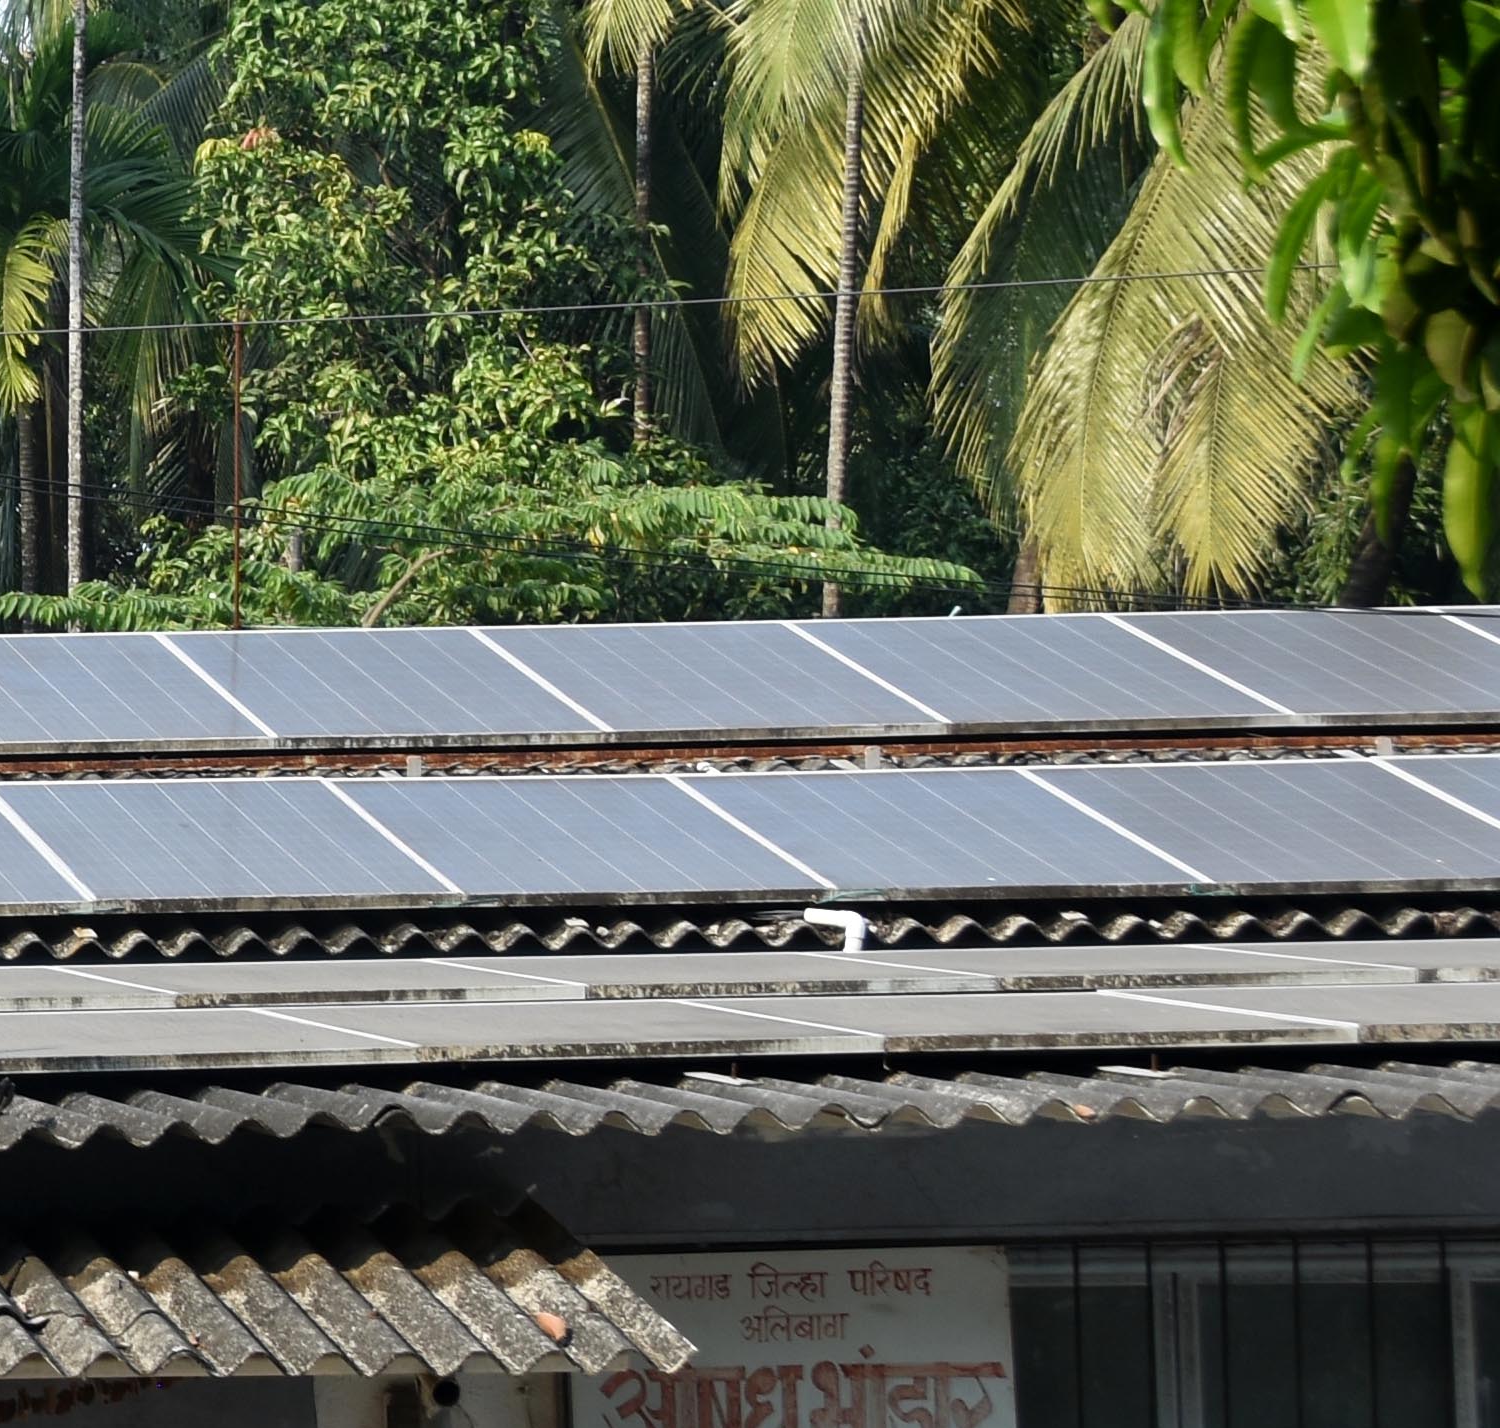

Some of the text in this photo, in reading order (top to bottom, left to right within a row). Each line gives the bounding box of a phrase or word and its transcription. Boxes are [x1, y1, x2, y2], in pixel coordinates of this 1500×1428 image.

[650, 1260, 932, 1299] रायगड जिल्हा परिषद
[741, 1305, 850, 1343] अलिबाग
